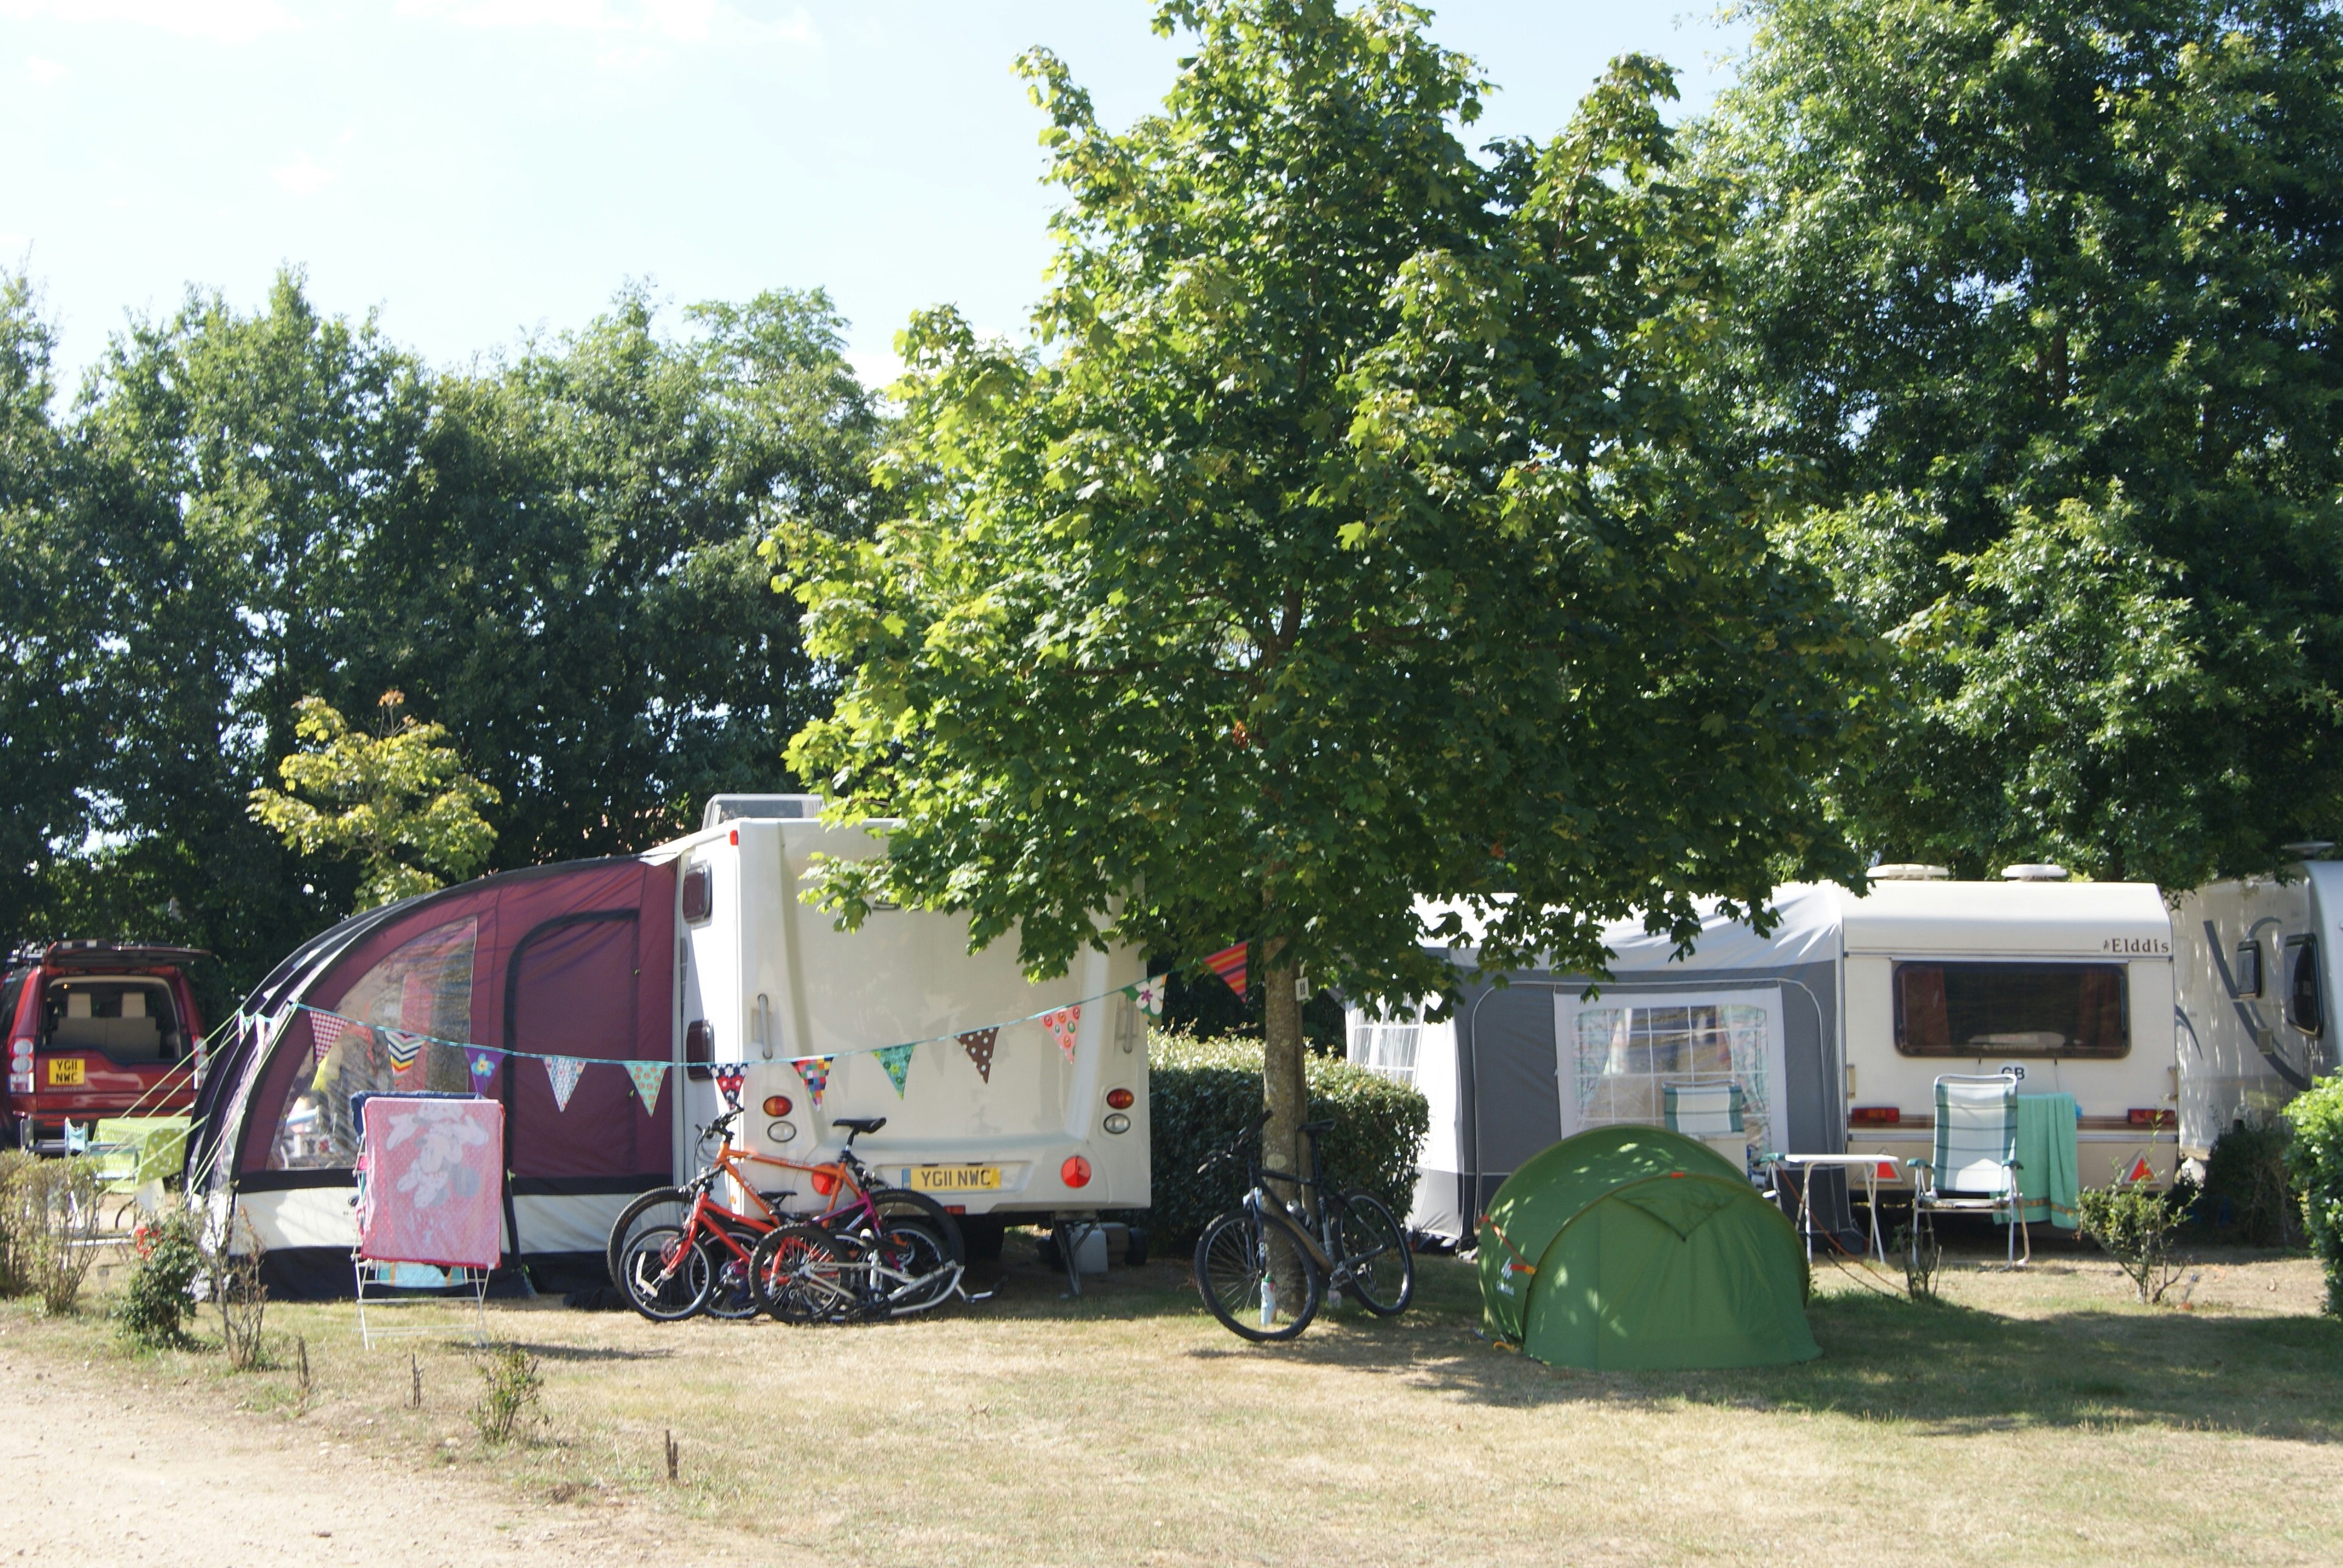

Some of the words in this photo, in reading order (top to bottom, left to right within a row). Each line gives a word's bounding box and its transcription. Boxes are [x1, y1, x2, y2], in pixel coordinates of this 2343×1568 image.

[2112, 938, 2169, 952] Elddis
[56, 1073, 77, 1082] NWC
[921, 1170, 952, 1187] YG11
[958, 1168, 991, 1186] NWC
